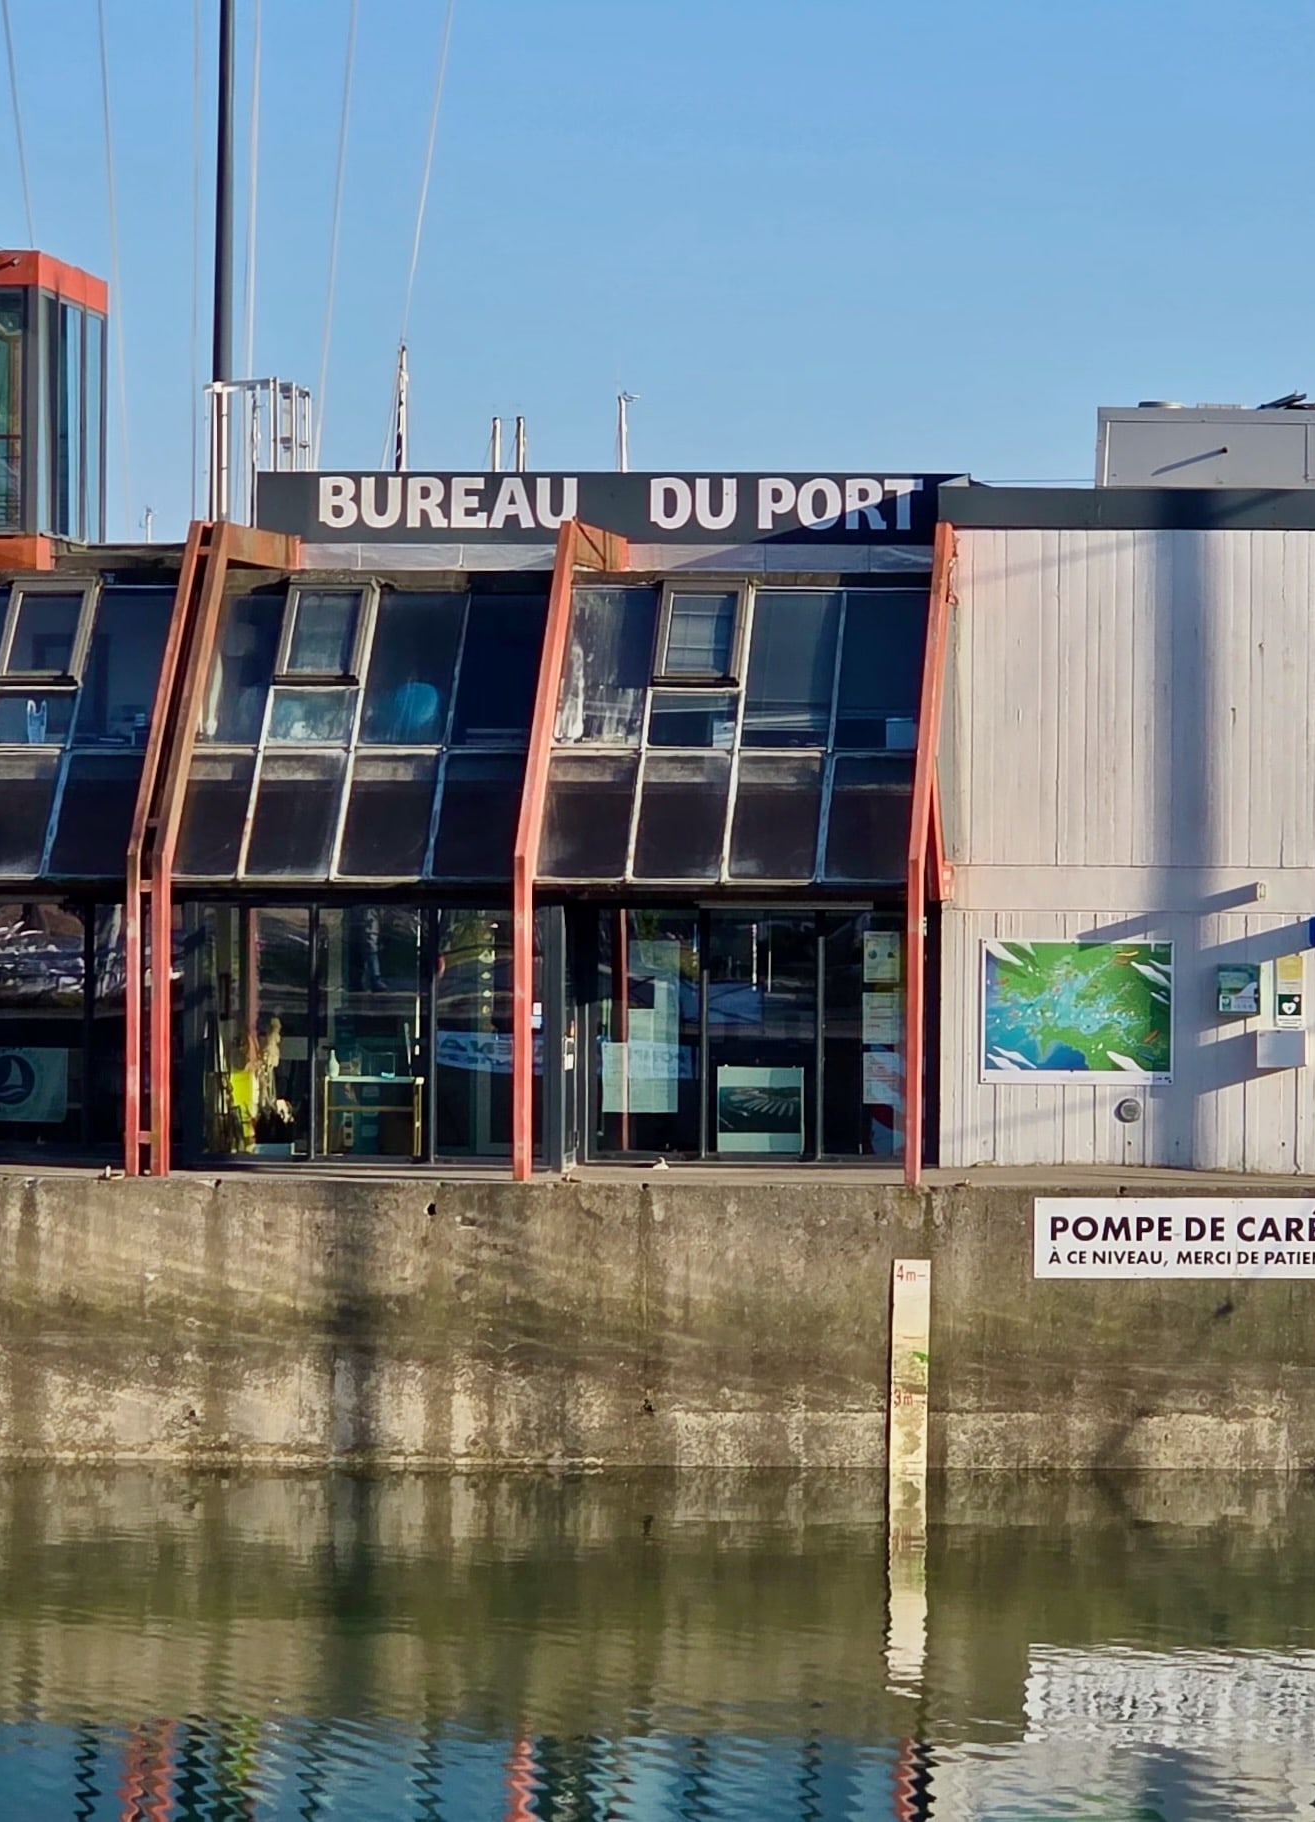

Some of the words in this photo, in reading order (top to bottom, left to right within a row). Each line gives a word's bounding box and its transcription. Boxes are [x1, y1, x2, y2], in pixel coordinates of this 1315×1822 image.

[319, 476, 578, 529] BUREAU
[650, 477, 738, 530] DU
[758, 477, 924, 530] PORT
[1050, 1216, 1173, 1242] POMPE
[1184, 1216, 1225, 1242] DE
[1048, 1246, 1061, 1265] À
[1066, 1250, 1087, 1265] CE
[1092, 1250, 1169, 1267] NIVEAU,
[1176, 1250, 1231, 1265] MERCI
[1237, 1251, 1259, 1265] DE
